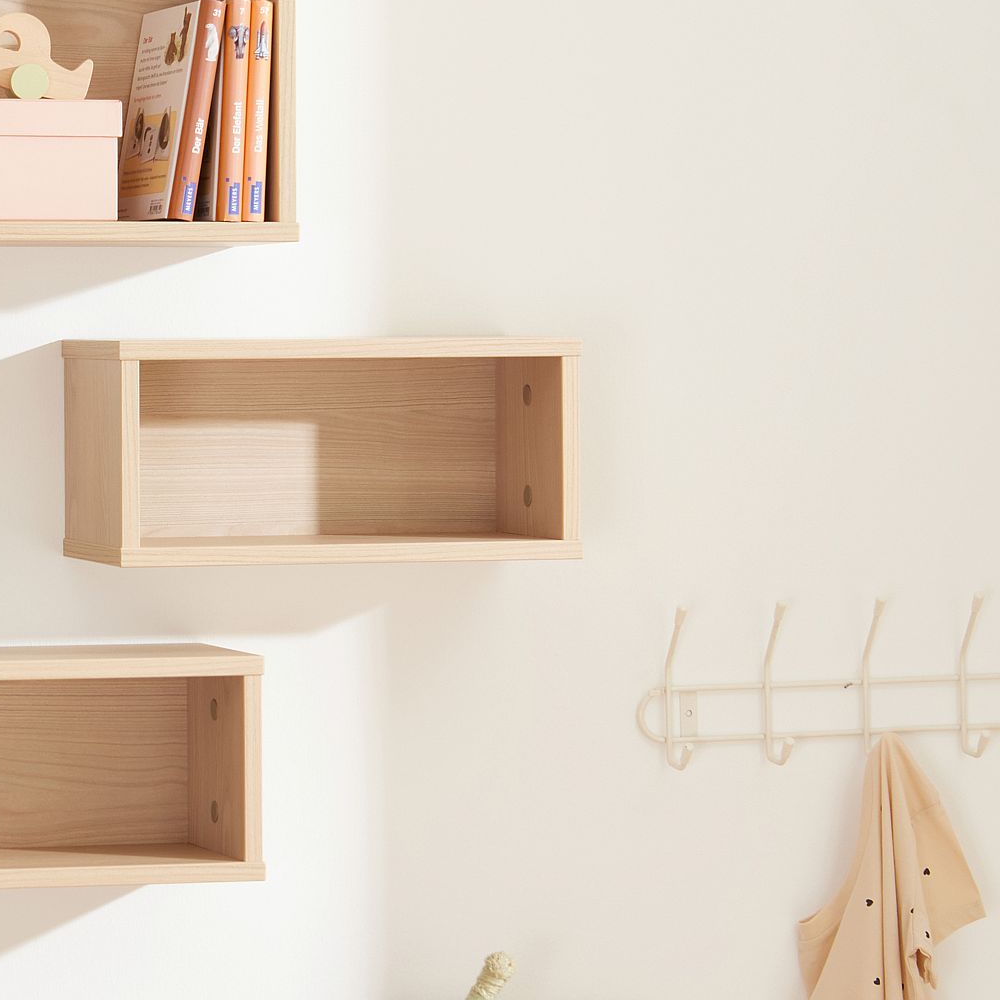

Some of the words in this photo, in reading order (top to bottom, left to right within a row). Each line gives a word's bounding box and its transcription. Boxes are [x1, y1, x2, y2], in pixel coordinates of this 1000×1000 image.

[212, 8, 222, 18] 31
[232, 101, 243, 135] Elefant
[255, 99, 265, 132] Weltall
[194, 117, 205, 135] Bär
[191, 137, 202, 154] Der
[231, 137, 241, 154] Der
[254, 134, 263, 153] Das
[185, 187, 194, 212] MEYERS
